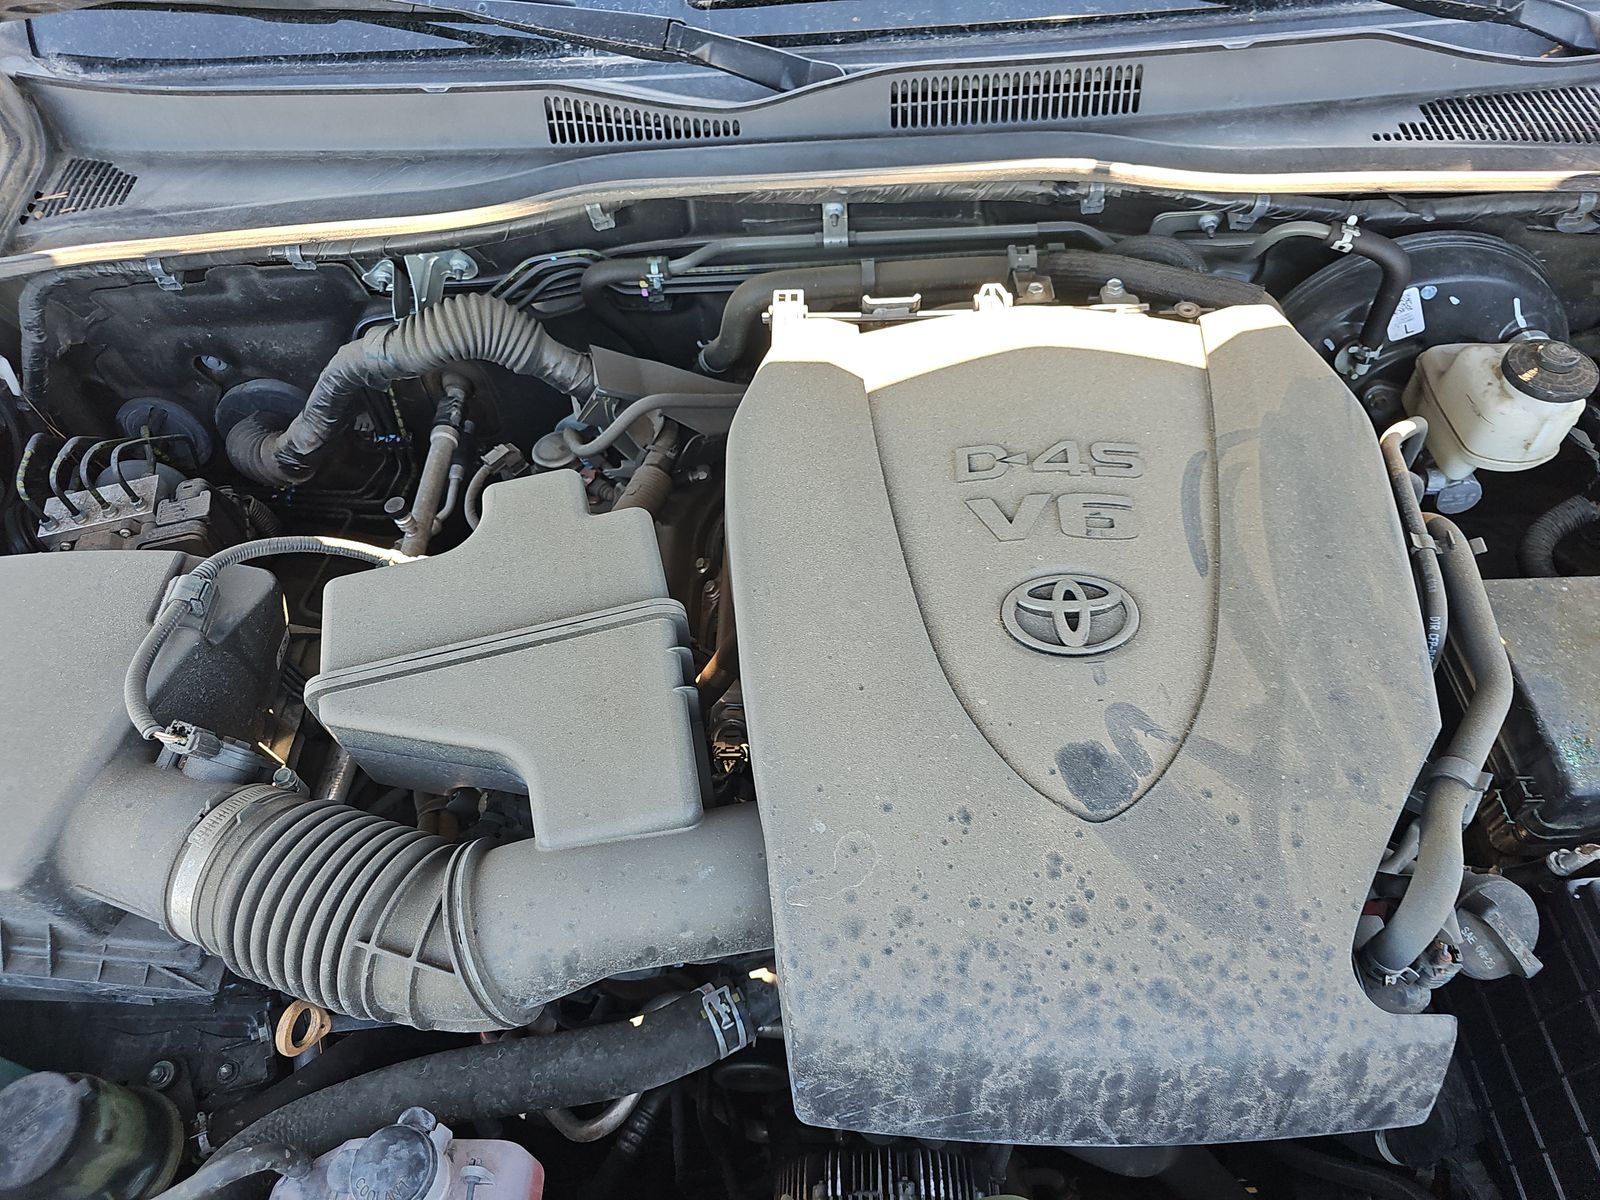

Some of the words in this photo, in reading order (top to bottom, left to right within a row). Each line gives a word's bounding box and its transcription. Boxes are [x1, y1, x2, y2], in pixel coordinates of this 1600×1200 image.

[1404, 324, 1415, 335] L
[953, 440, 1143, 483] D-4S
[963, 493, 1139, 542] V6
[1429, 616, 1441, 631] DTR
[1461, 926, 1478, 945] SAE
